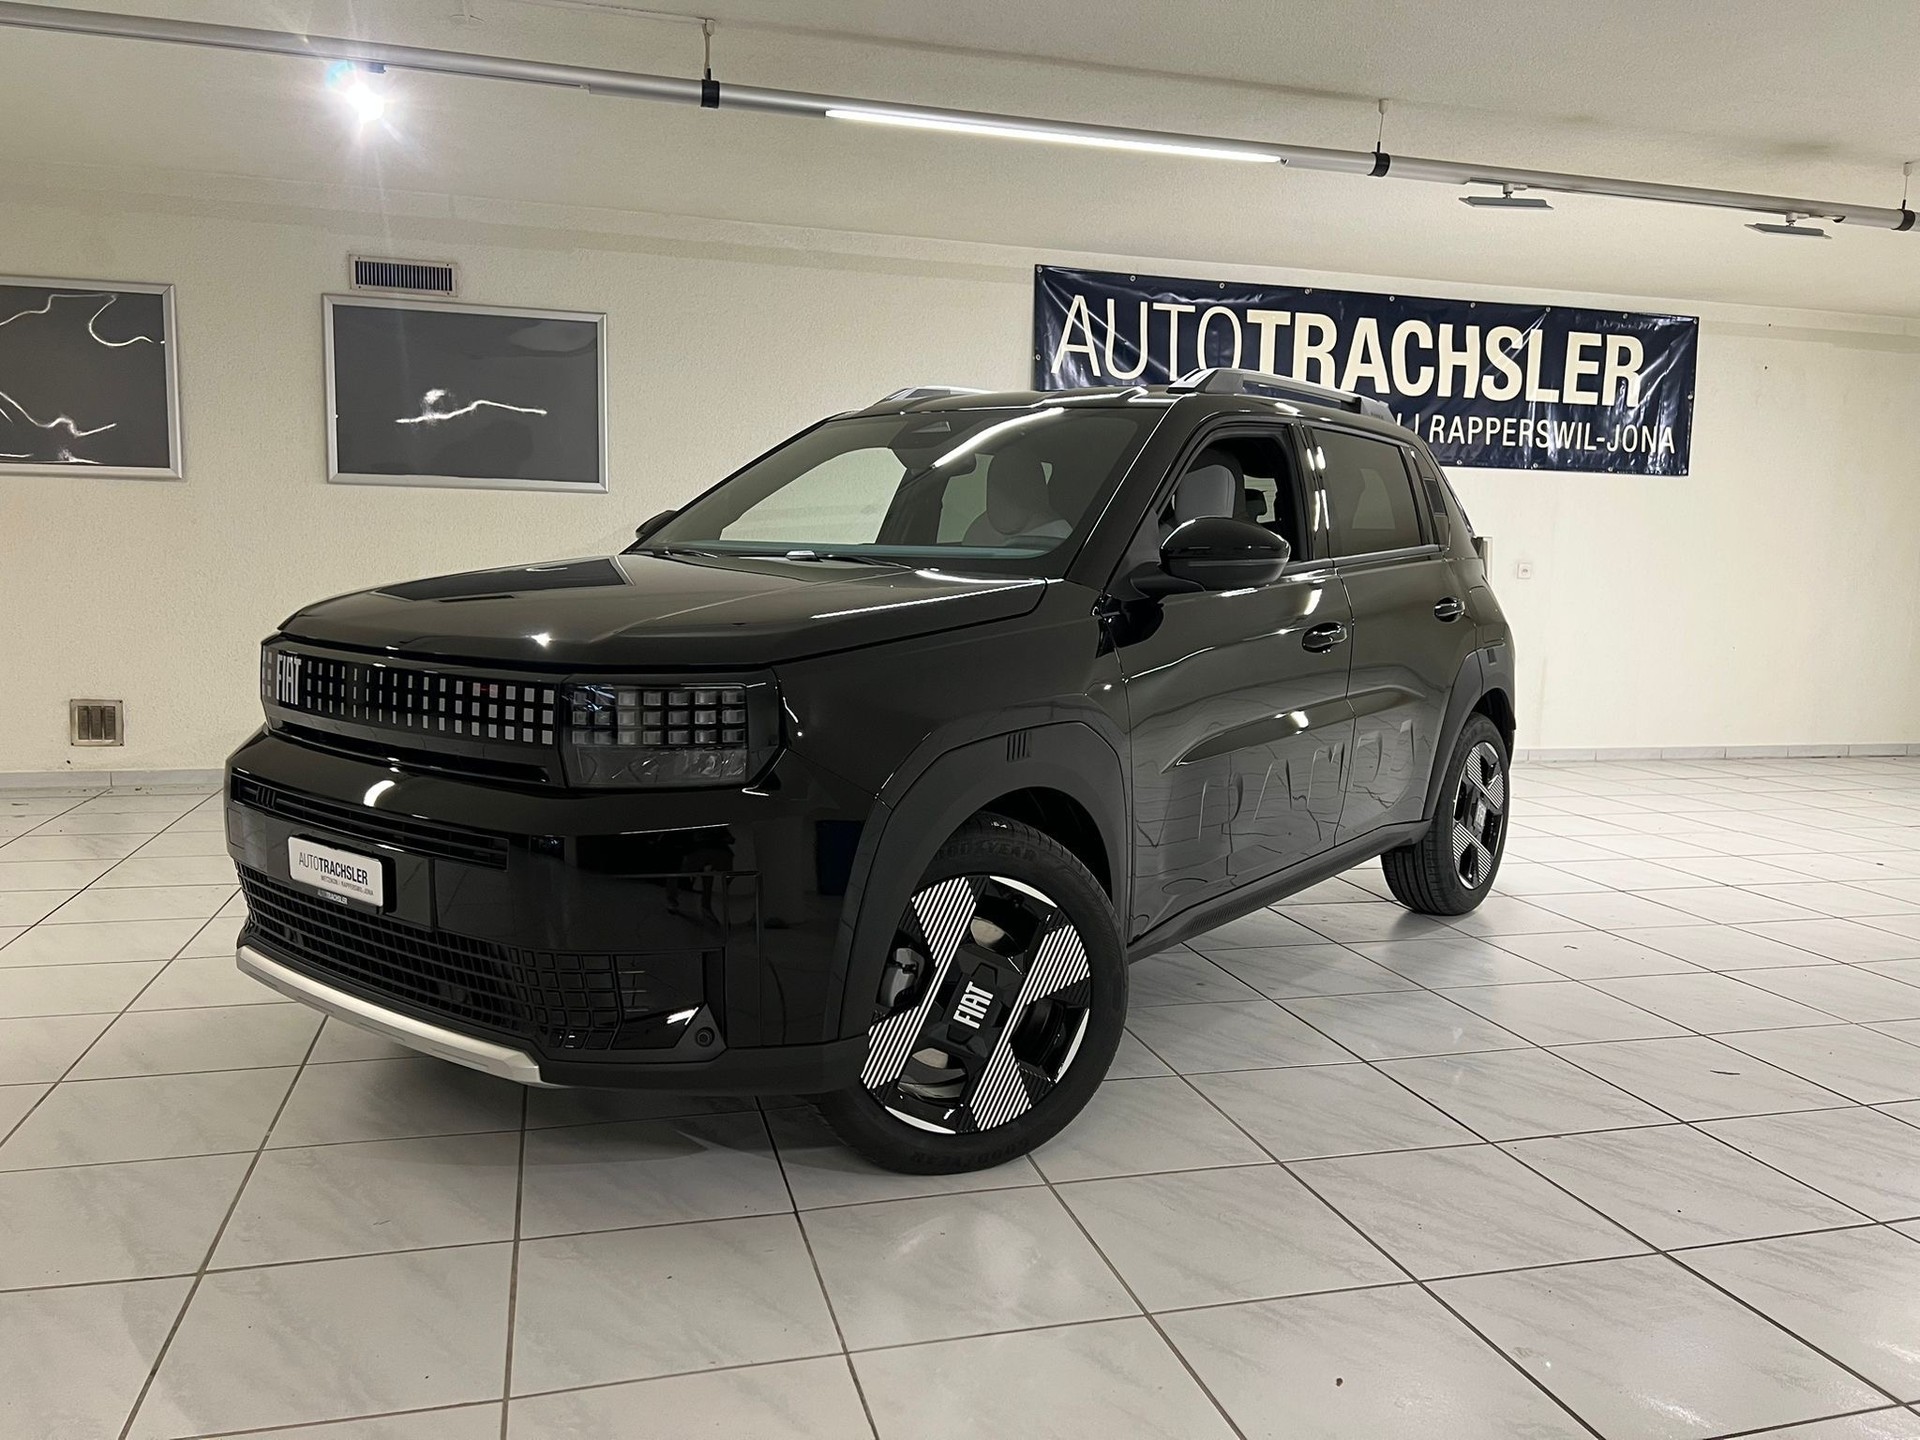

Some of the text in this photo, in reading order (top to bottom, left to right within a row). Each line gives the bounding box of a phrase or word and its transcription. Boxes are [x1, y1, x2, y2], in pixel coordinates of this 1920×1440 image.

[1051, 293, 1644, 409] AUTOTRACHSLER
[1428, 413, 1676, 454] RAPPERSWIL-JONA
[276, 654, 301, 705] FIAT
[299, 852, 368, 885] AUTOTRACHSLER
[953, 981, 994, 1029] FIAT
